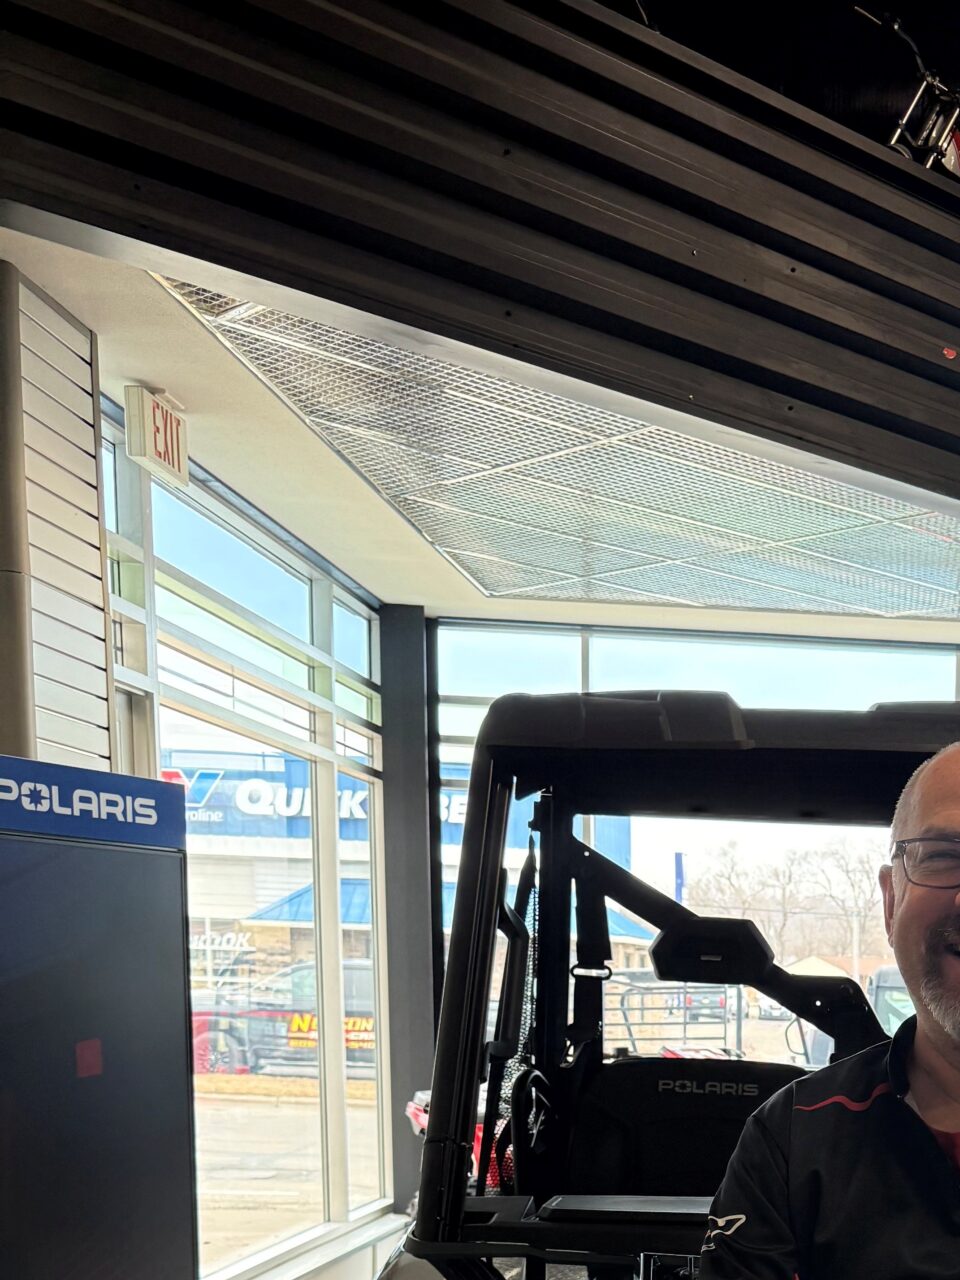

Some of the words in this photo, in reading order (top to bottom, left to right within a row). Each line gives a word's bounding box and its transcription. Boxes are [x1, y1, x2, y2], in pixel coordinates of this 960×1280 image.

[152, 399, 181, 474] EXIT
[0, 778, 158, 825] POLARIS
[235, 778, 369, 819] QUIK
[658, 1080, 759, 1096] POLARIS
